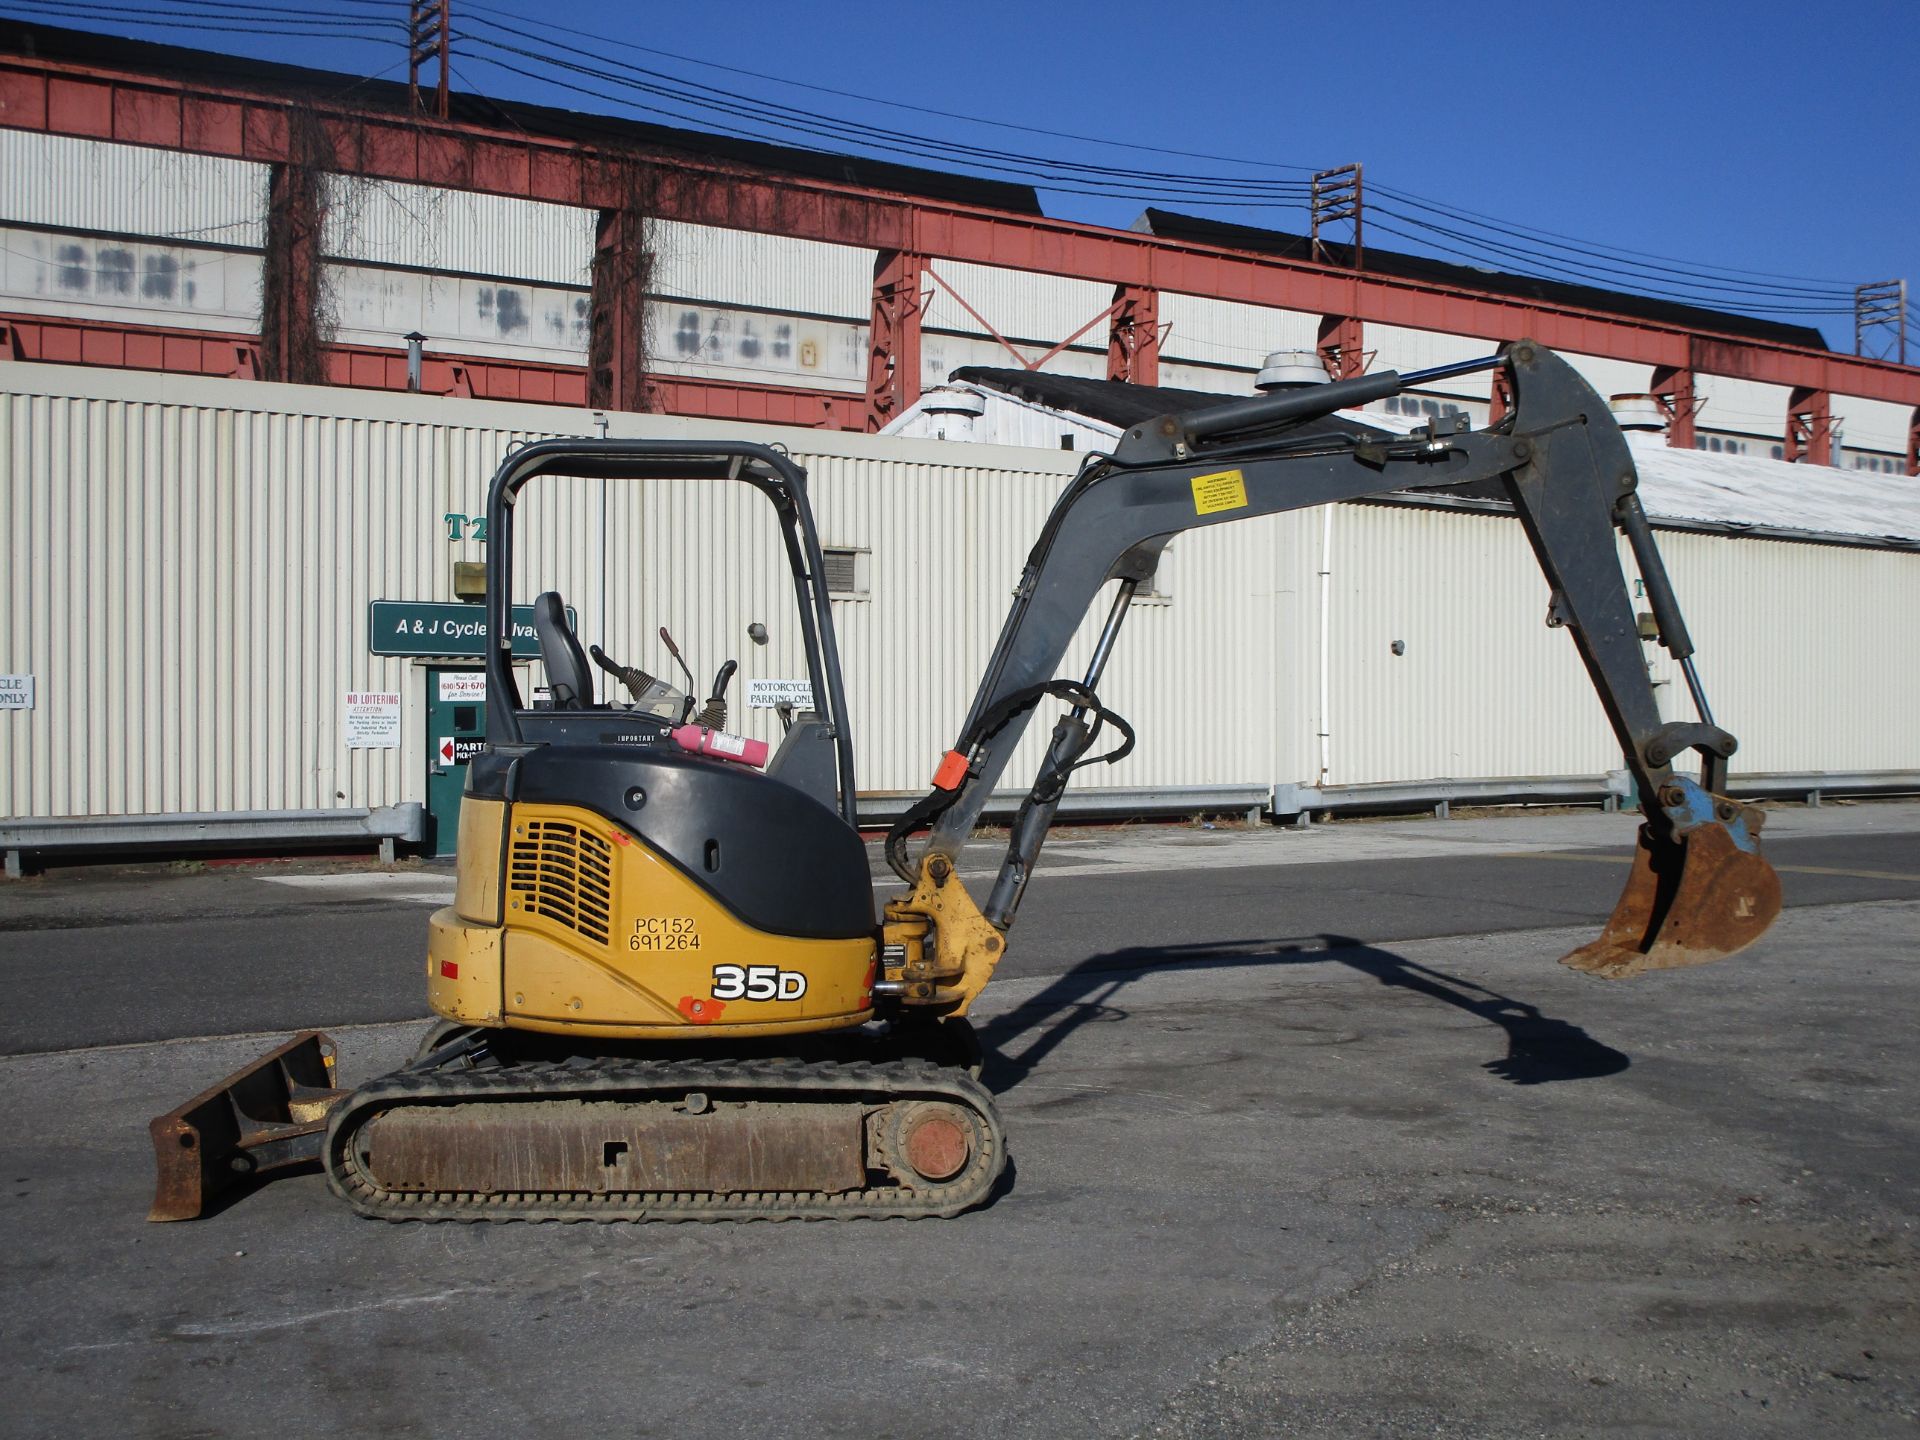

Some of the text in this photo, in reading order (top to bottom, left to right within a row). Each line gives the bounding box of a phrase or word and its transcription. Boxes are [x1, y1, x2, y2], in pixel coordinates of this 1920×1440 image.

[1634, 578, 1648, 598] T
[396, 619, 408, 634] A
[413, 619, 424, 634] &
[428, 620, 439, 635] J
[443, 620, 487, 639] Cycle
[753, 683, 812, 692] MOTORCYCLE
[347, 694, 399, 704] NO LOITERING
[750, 694, 815, 704] PARKING ONL
[635, 918, 695, 934] PC152
[629, 934, 701, 950] 691264
[711, 964, 808, 1001] 35D
